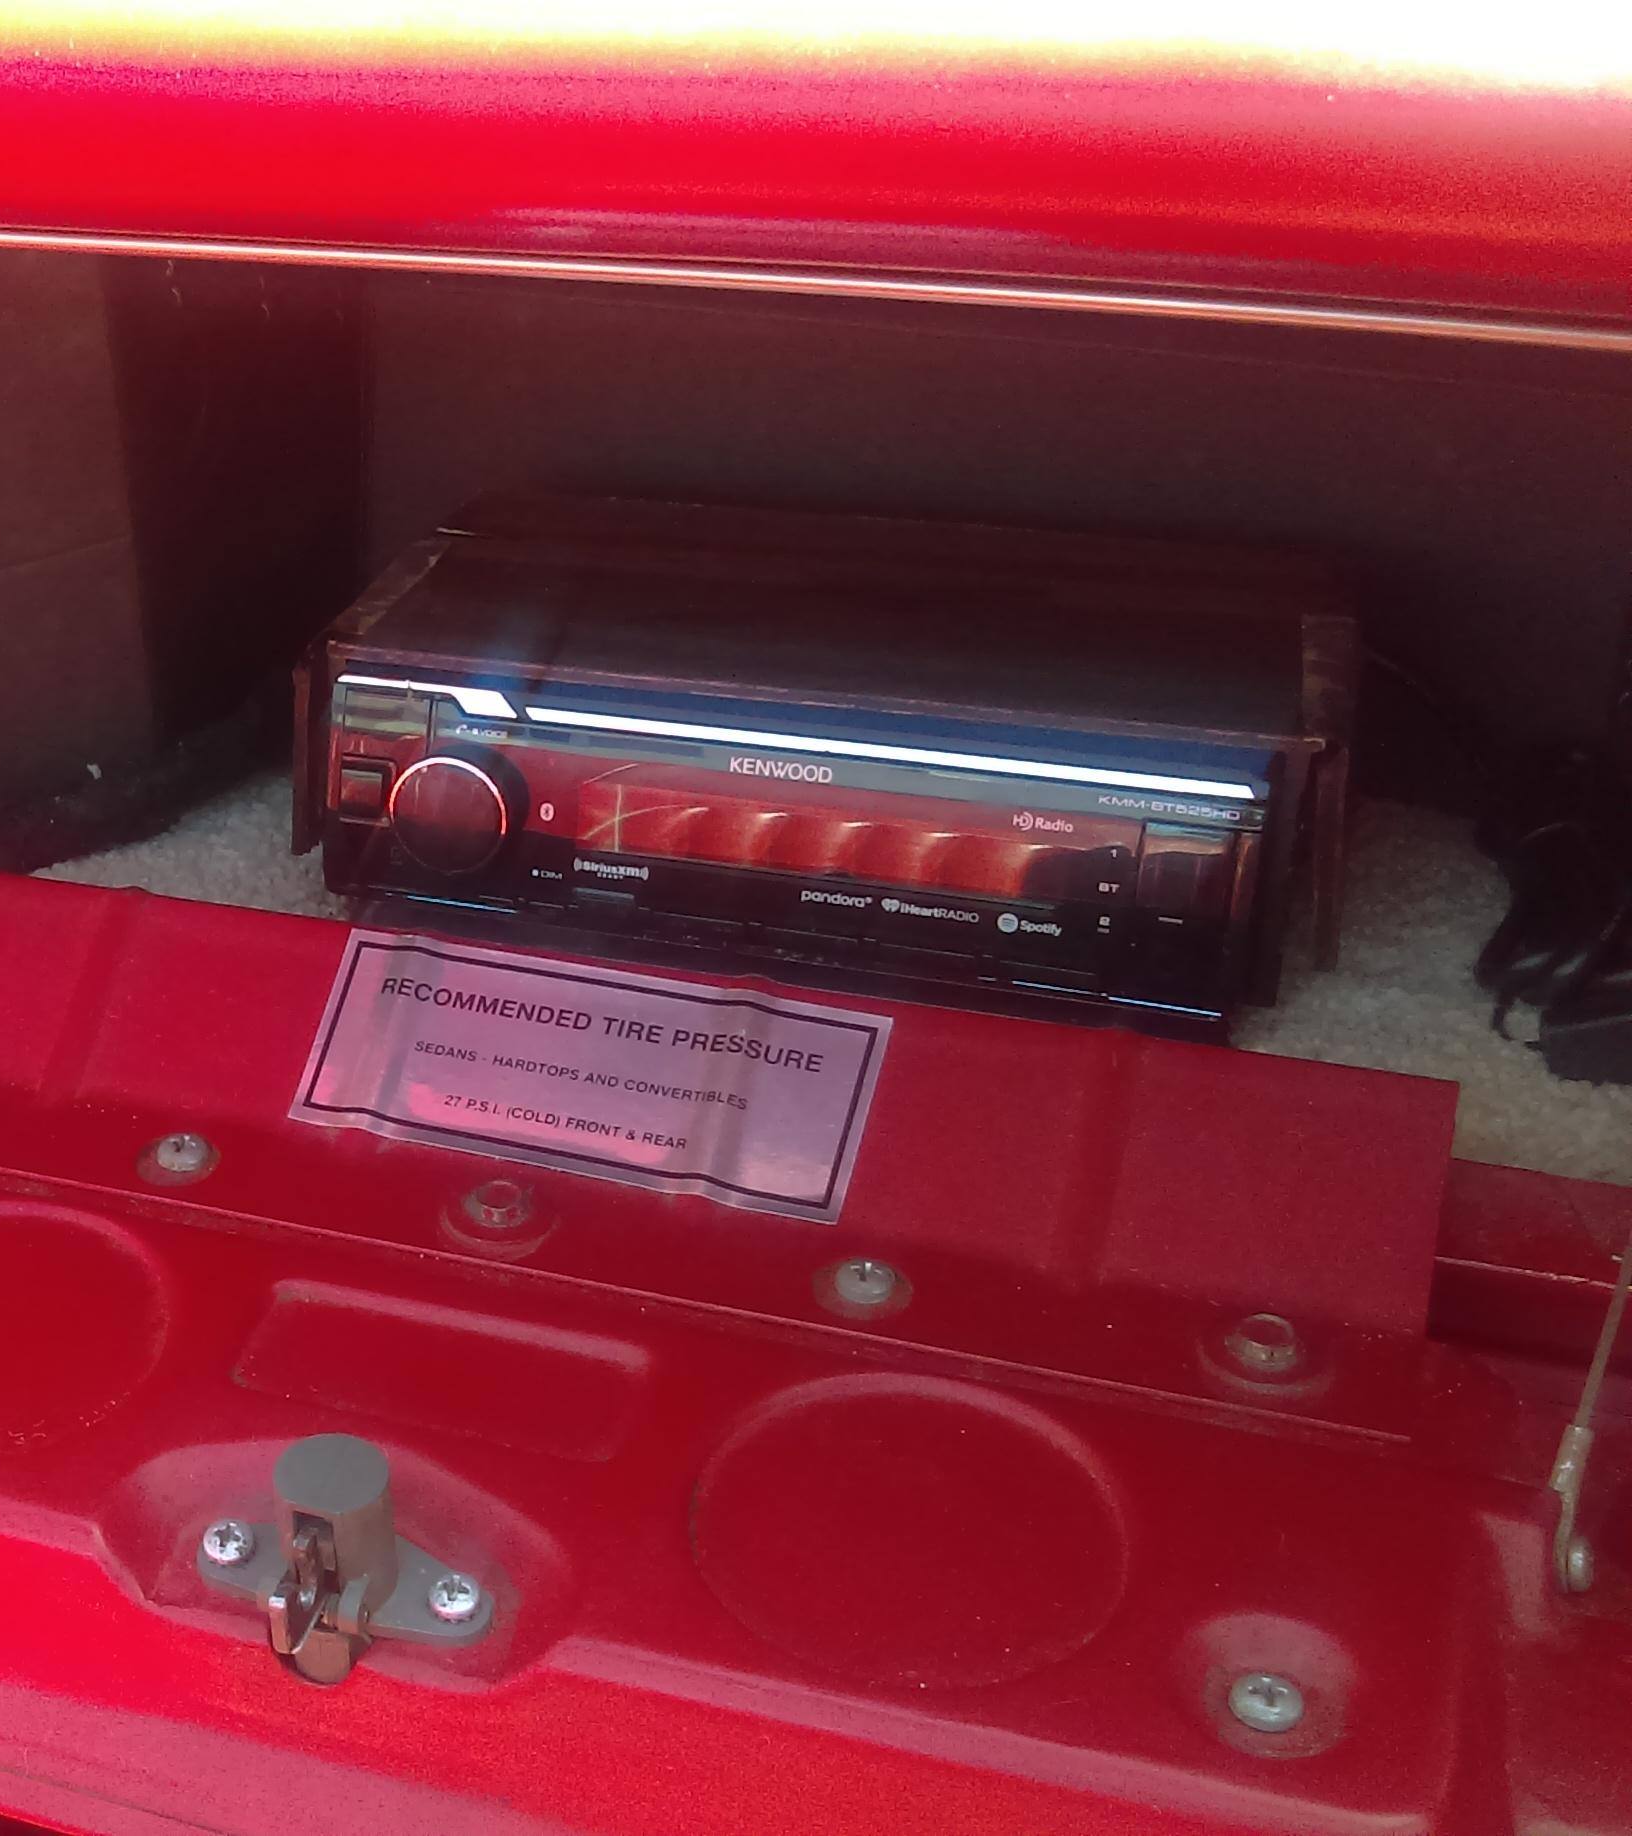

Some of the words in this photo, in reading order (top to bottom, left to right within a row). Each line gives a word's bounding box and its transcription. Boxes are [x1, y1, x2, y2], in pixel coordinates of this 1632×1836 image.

[729, 756, 833, 784] KENWOOD
[1098, 796, 1241, 821] KMM-BT525HD
[1035, 817, 1074, 833] Radio
[800, 890, 867, 909] pandora
[1098, 881, 1120, 894] BT
[1020, 919, 1063, 937] Spotify
[380, 977, 593, 1031] RECOMMENDED
[603, 1016, 664, 1045] TIRE
[671, 1028, 824, 1073] PRESSURE
[414, 1040, 478, 1062] SEDANS
[492, 1054, 581, 1081] HARDTOPS
[583, 1072, 619, 1088] AND
[623, 1078, 749, 1110] CONVERTIBLES
[444, 1095, 462, 1107] 27
[465, 1098, 500, 1116] P.S.I.
[506, 1106, 561, 1128] (COLD)
[565, 1116, 621, 1138] FRONT
[625, 1129, 636, 1141] &
[641, 1131, 688, 1150] REAR
